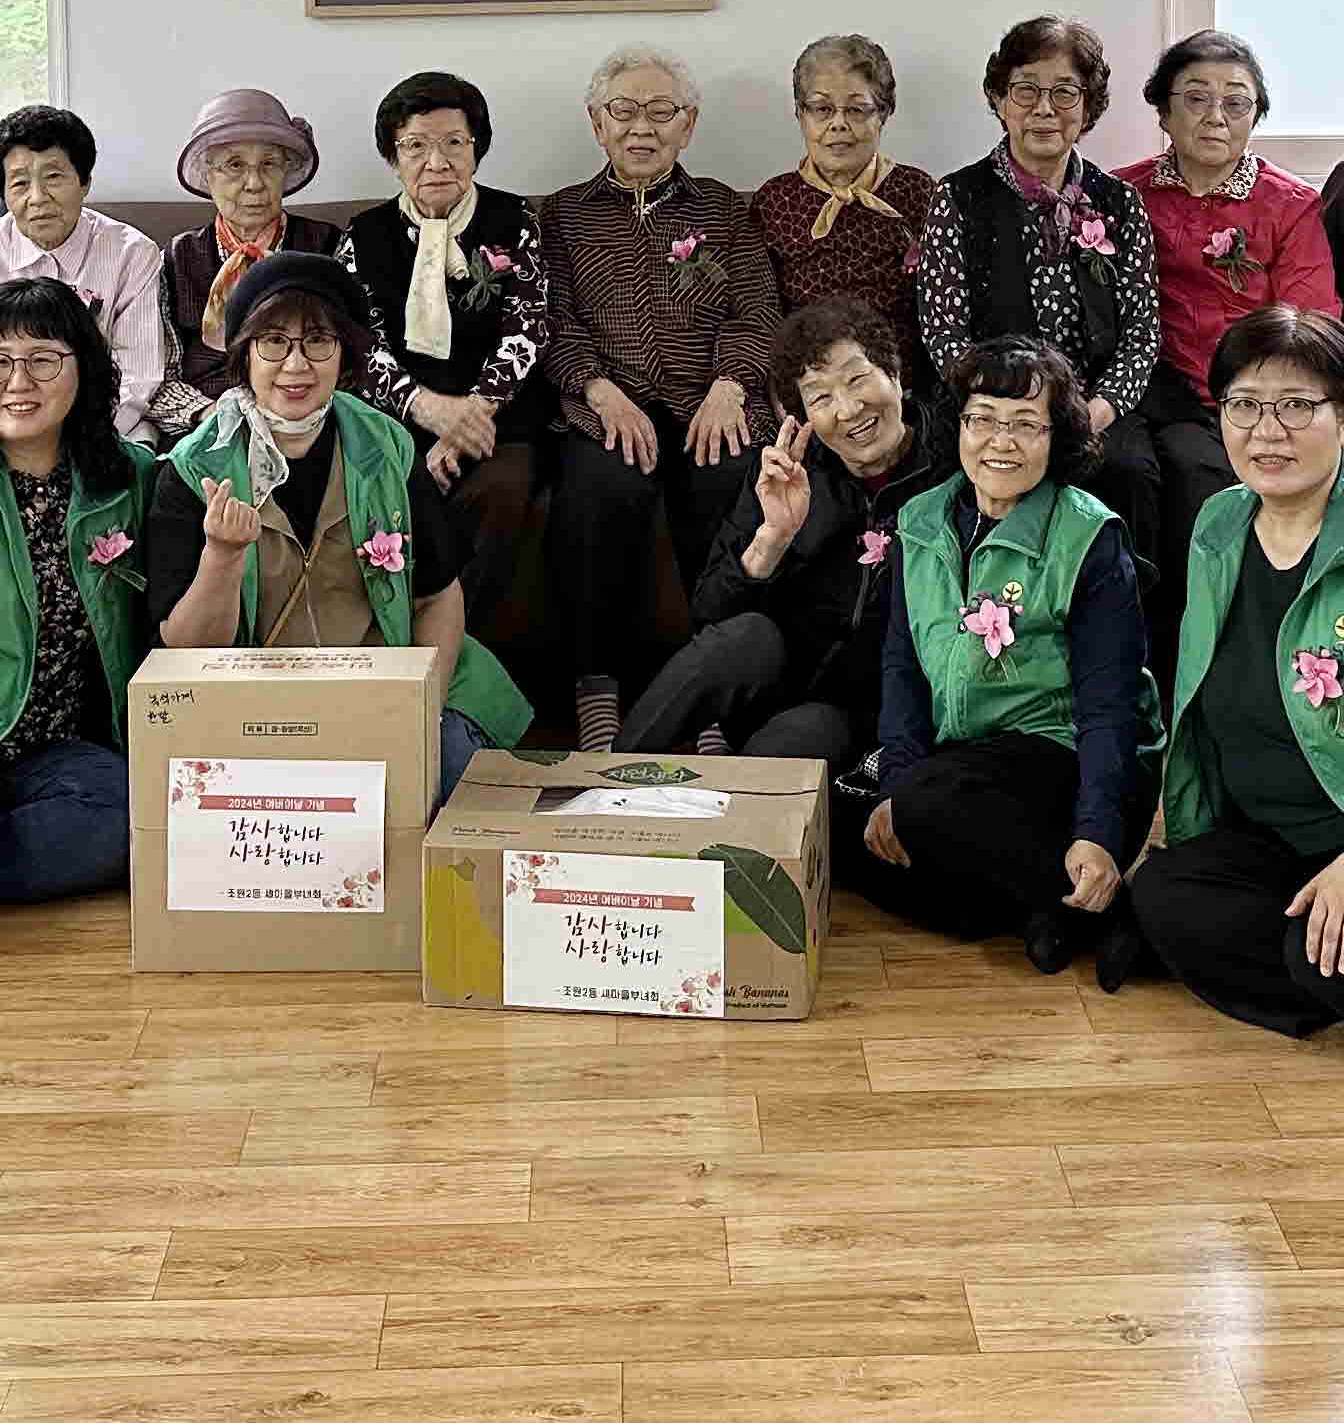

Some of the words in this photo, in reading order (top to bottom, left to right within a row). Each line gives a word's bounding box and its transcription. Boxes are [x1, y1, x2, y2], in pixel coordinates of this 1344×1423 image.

[228, 797, 263, 809] 2024년
[264, 798, 303, 810] 어버이날
[306, 799, 325, 810] 기념
[228, 817, 325, 842] 감사합니다
[228, 842, 325, 866] 사랑합니다
[264, 888, 322, 900] 새마을부녀회
[562, 892, 598, 905] 2024년
[601, 894, 641, 907] 어버이날
[644, 896, 664, 908] 기념
[564, 912, 664, 940] 감사합니다
[564, 938, 664, 965] 사랑합니다
[561, 985, 598, 999] 조원2동
[601, 986, 660, 1002] 새마을부녀회
[739, 984, 790, 999] Bananas
